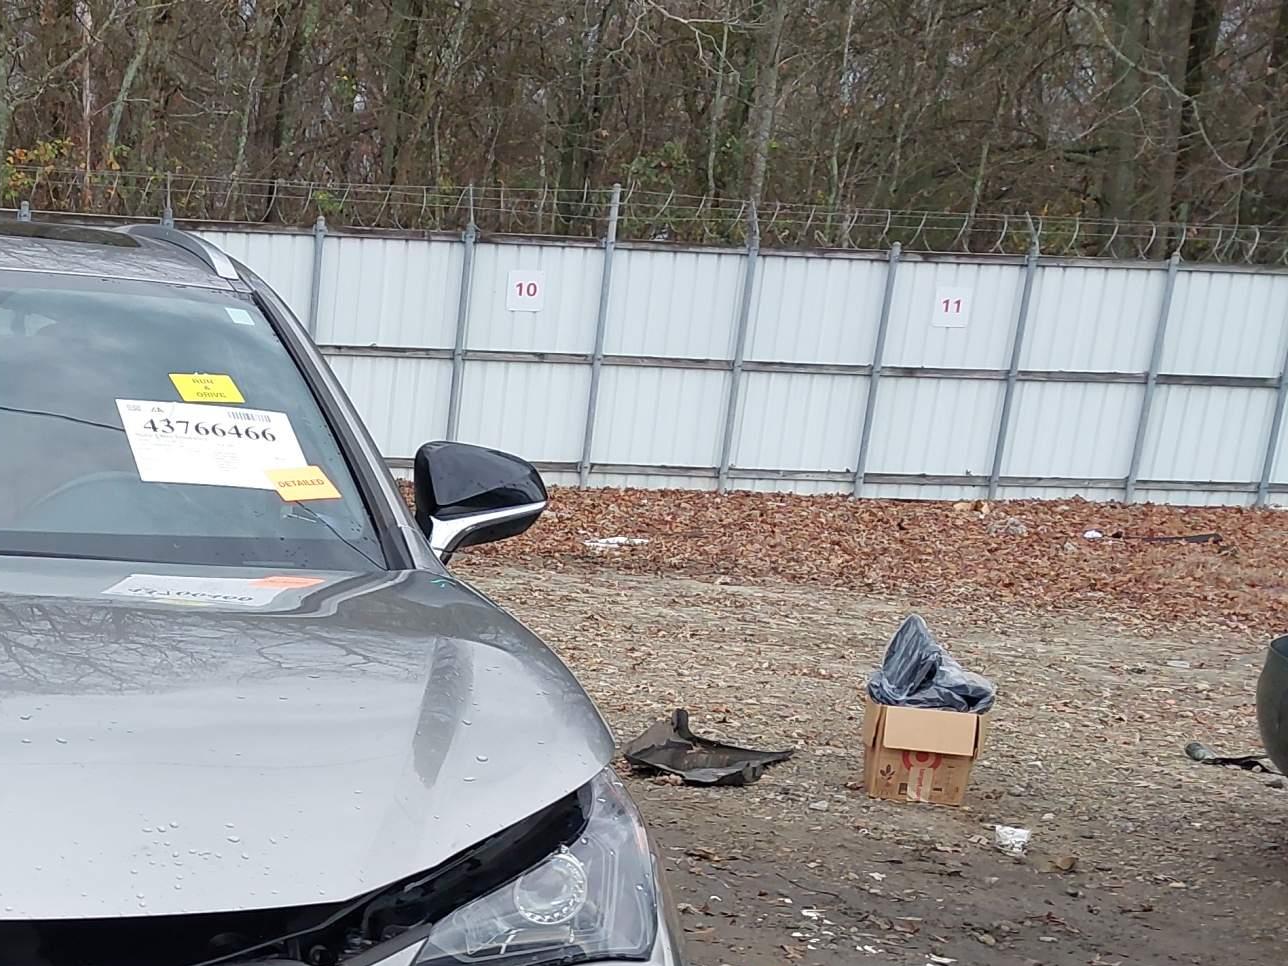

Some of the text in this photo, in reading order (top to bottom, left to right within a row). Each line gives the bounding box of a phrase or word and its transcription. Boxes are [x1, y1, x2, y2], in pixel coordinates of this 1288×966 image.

[515, 282, 537, 297] 10
[942, 298, 962, 313] 11
[143, 418, 276, 442] 43766466
[278, 479, 325, 488] DETAILED
